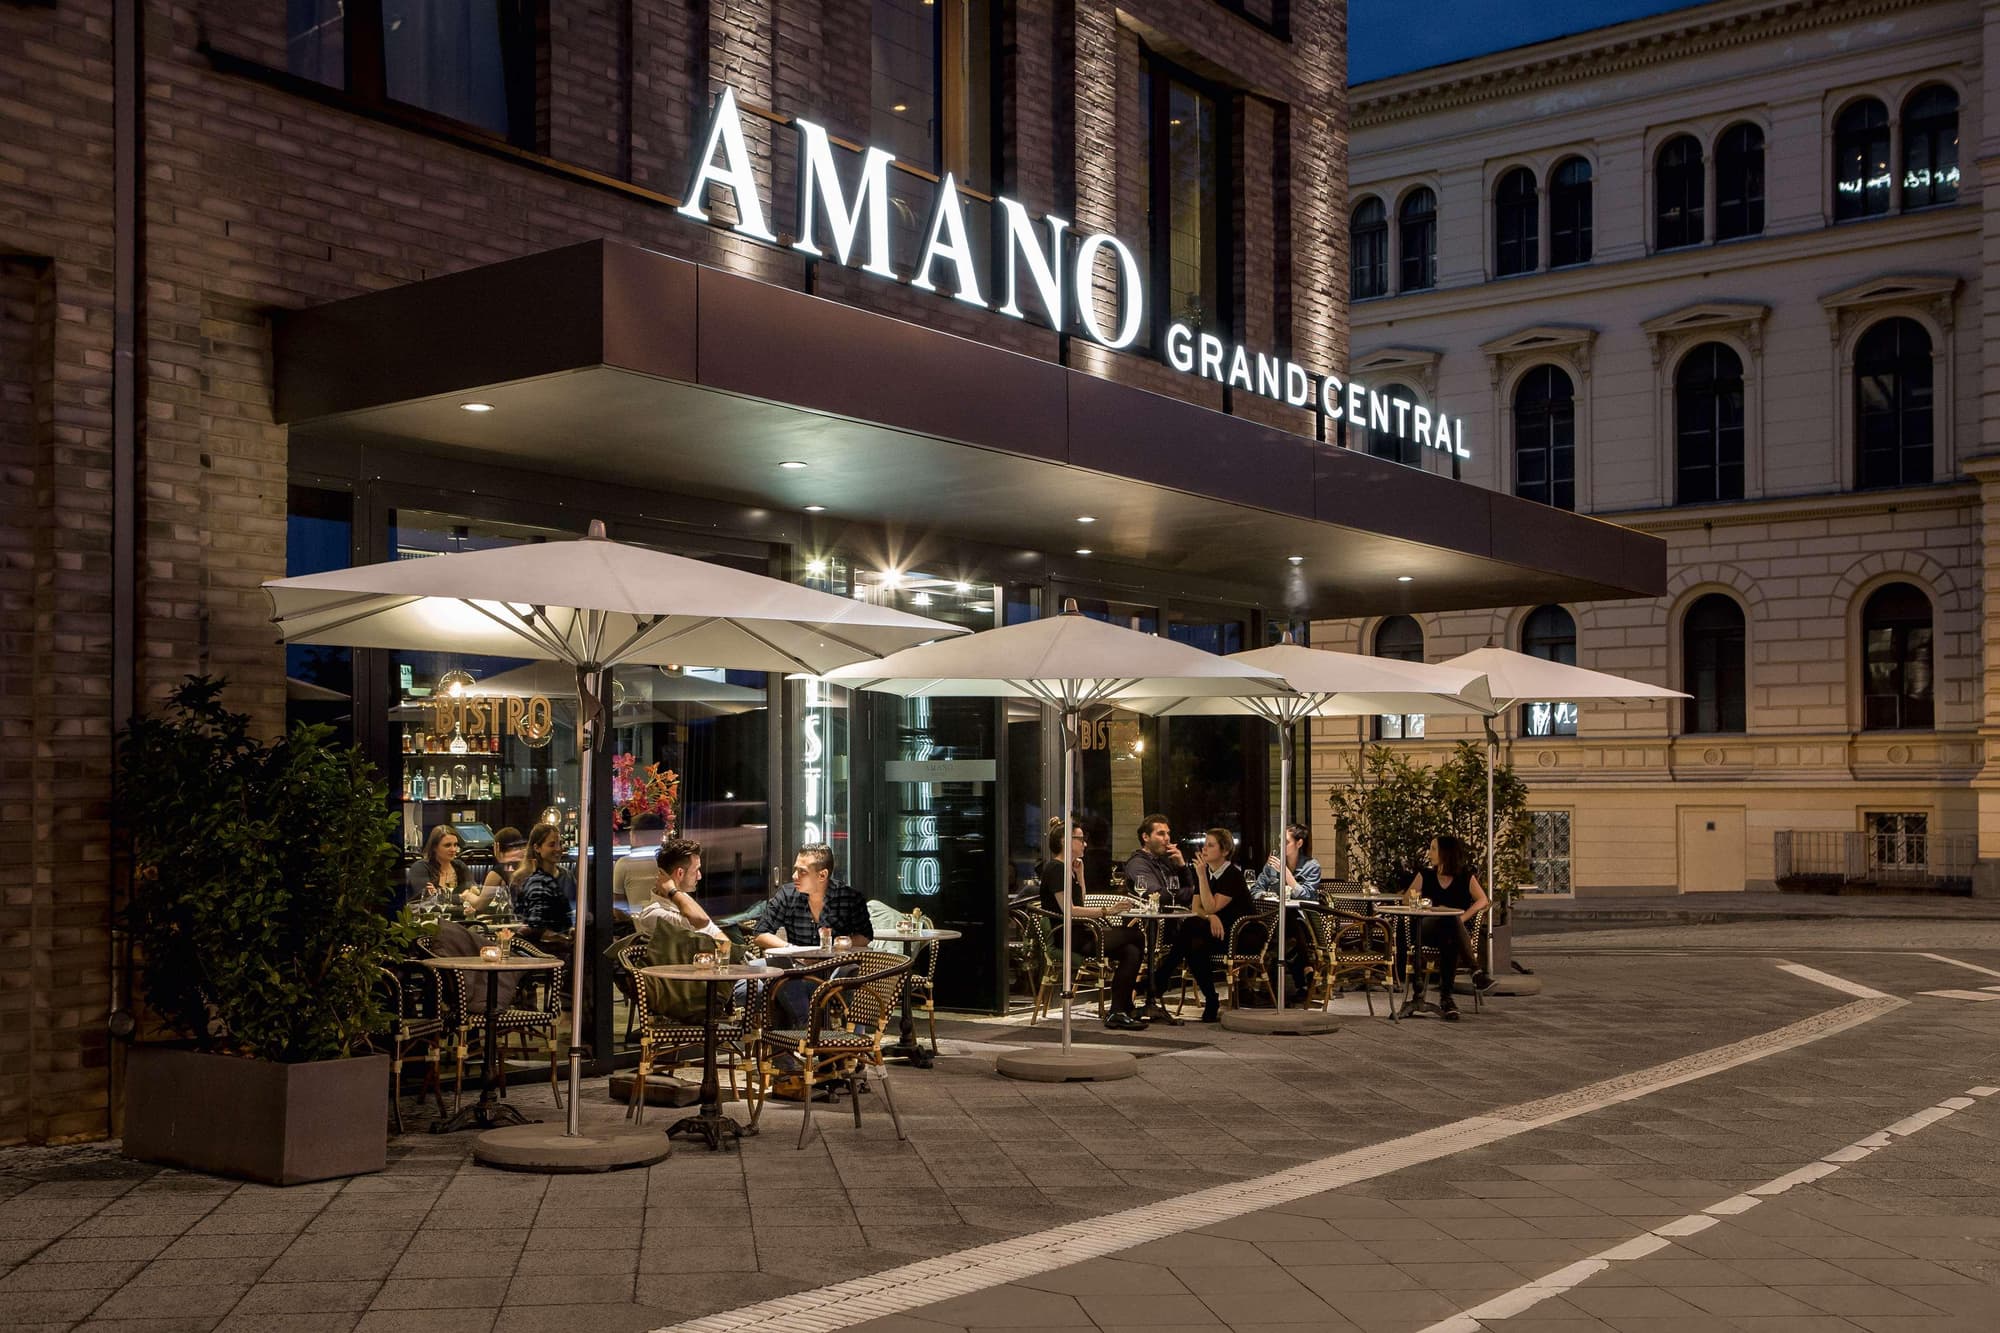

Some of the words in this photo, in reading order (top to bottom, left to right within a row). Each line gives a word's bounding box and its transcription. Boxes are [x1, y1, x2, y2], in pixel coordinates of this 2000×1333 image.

[677, 85, 1143, 349] AMANO
[1167, 323, 1308, 406] GRAND
[1322, 375, 1470, 458] CENTRAL
[435, 693, 552, 738] BISTRO
